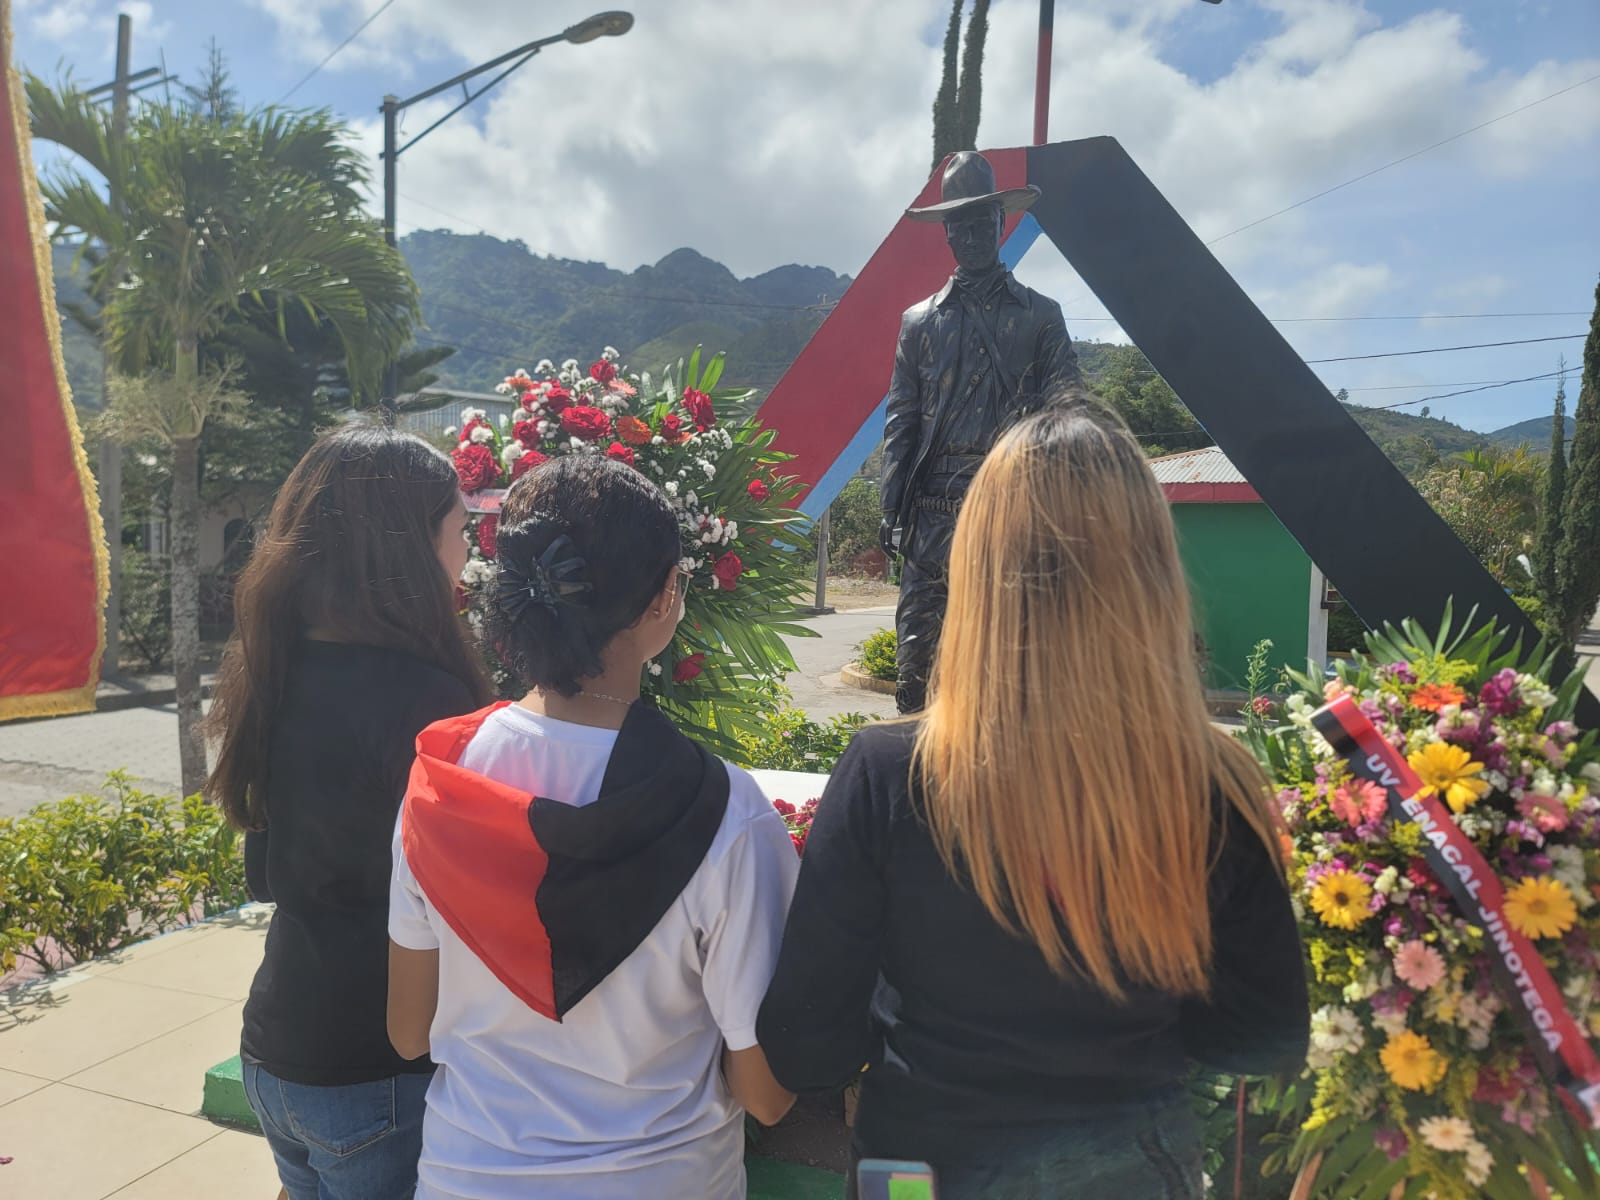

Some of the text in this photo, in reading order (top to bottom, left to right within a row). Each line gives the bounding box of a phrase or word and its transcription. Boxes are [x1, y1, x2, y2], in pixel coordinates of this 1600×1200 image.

[1366, 754, 1563, 1053] UV ENACAL JINOTEGA
